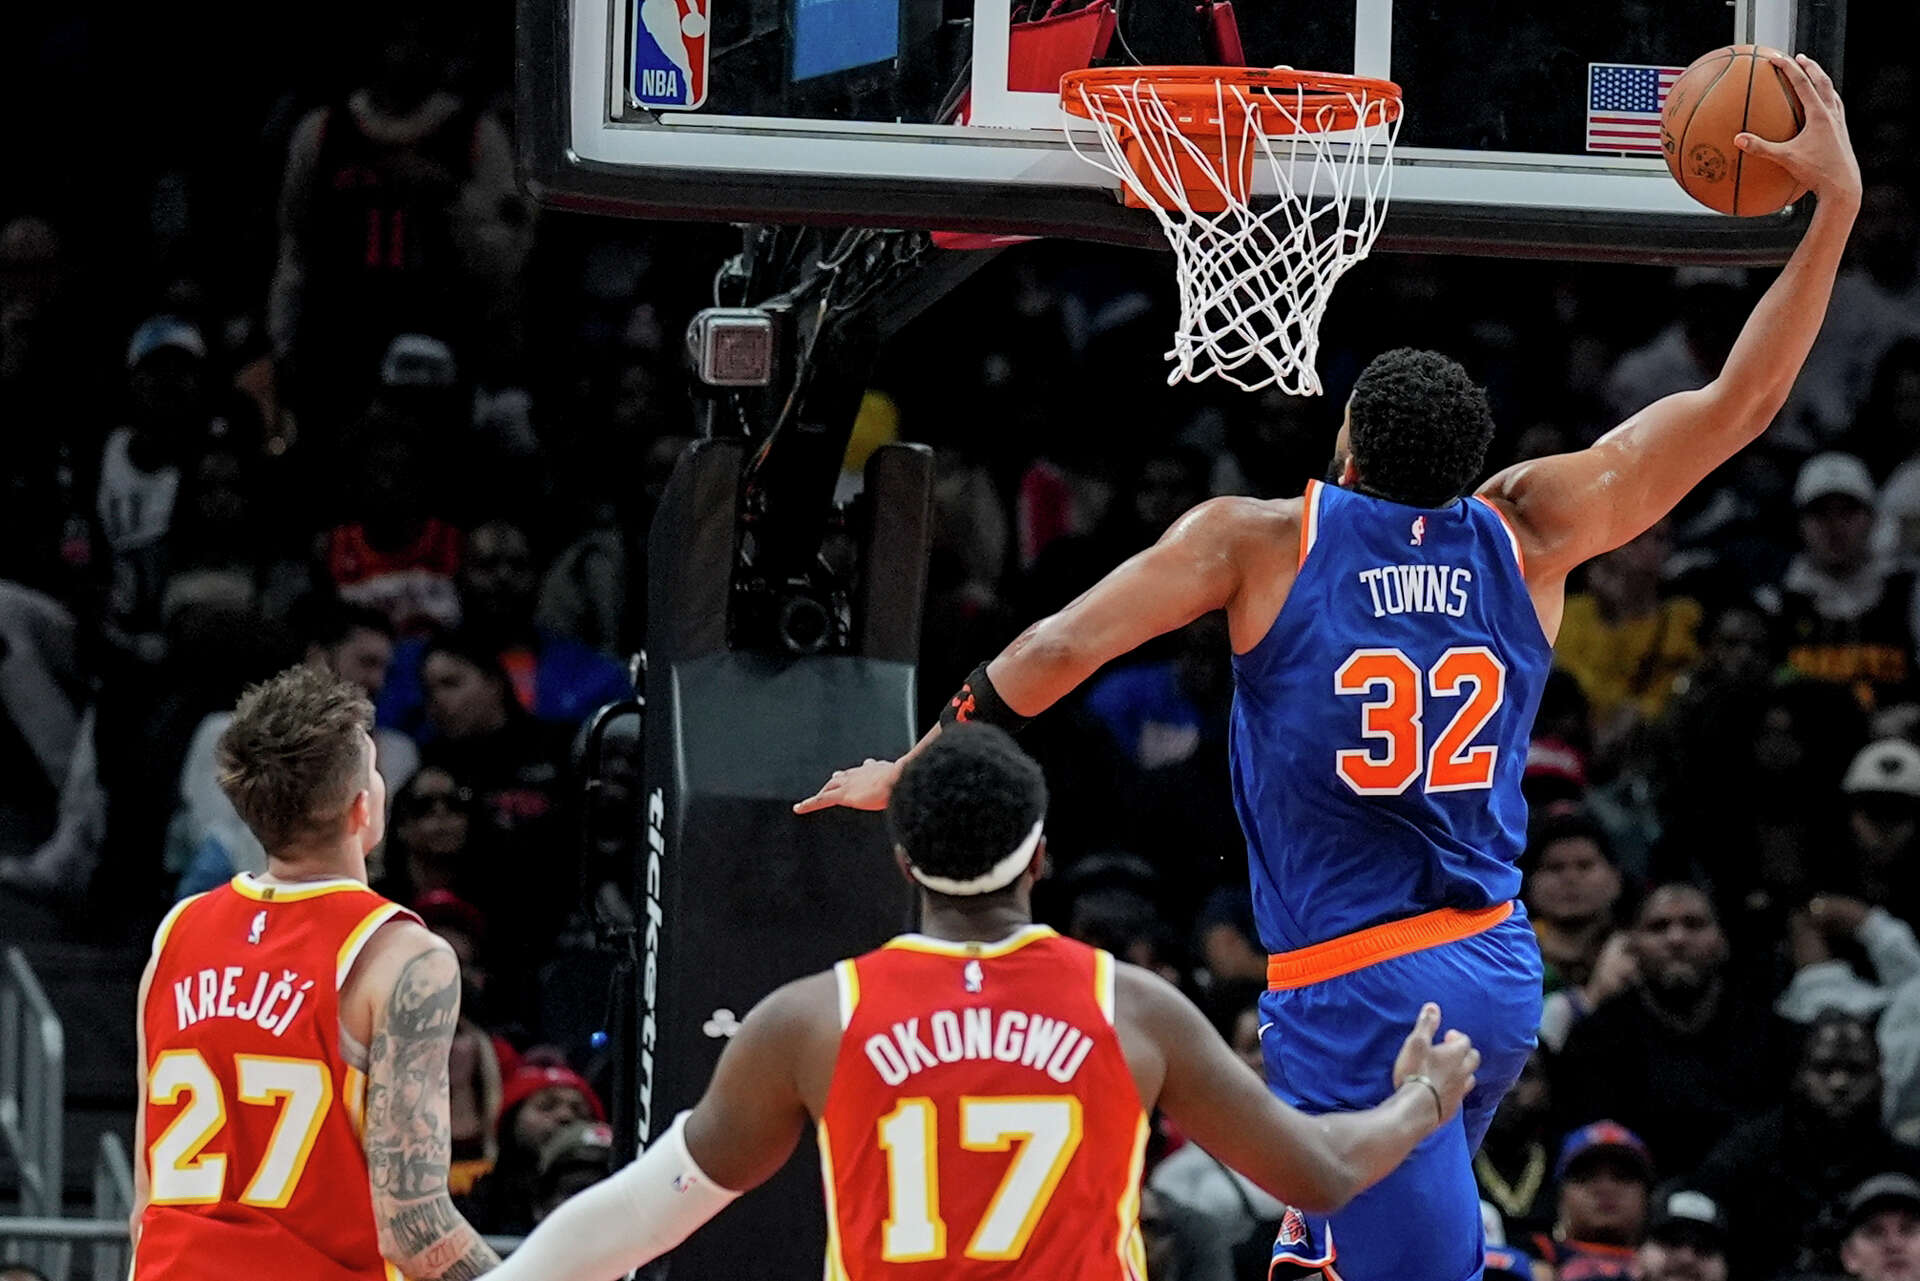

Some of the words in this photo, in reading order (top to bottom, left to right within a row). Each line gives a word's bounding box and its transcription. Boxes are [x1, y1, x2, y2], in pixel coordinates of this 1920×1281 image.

[642, 69, 678, 97] NBA
[1359, 565, 1472, 618] TOWNS
[1334, 646, 1506, 796] 32
[174, 966, 315, 1037] KREJČÍ
[633, 787, 665, 1161] ticketm
[864, 1007, 1095, 1087] OKONGWU
[148, 1048, 335, 1209] 27
[877, 1094, 1085, 1263] 17
